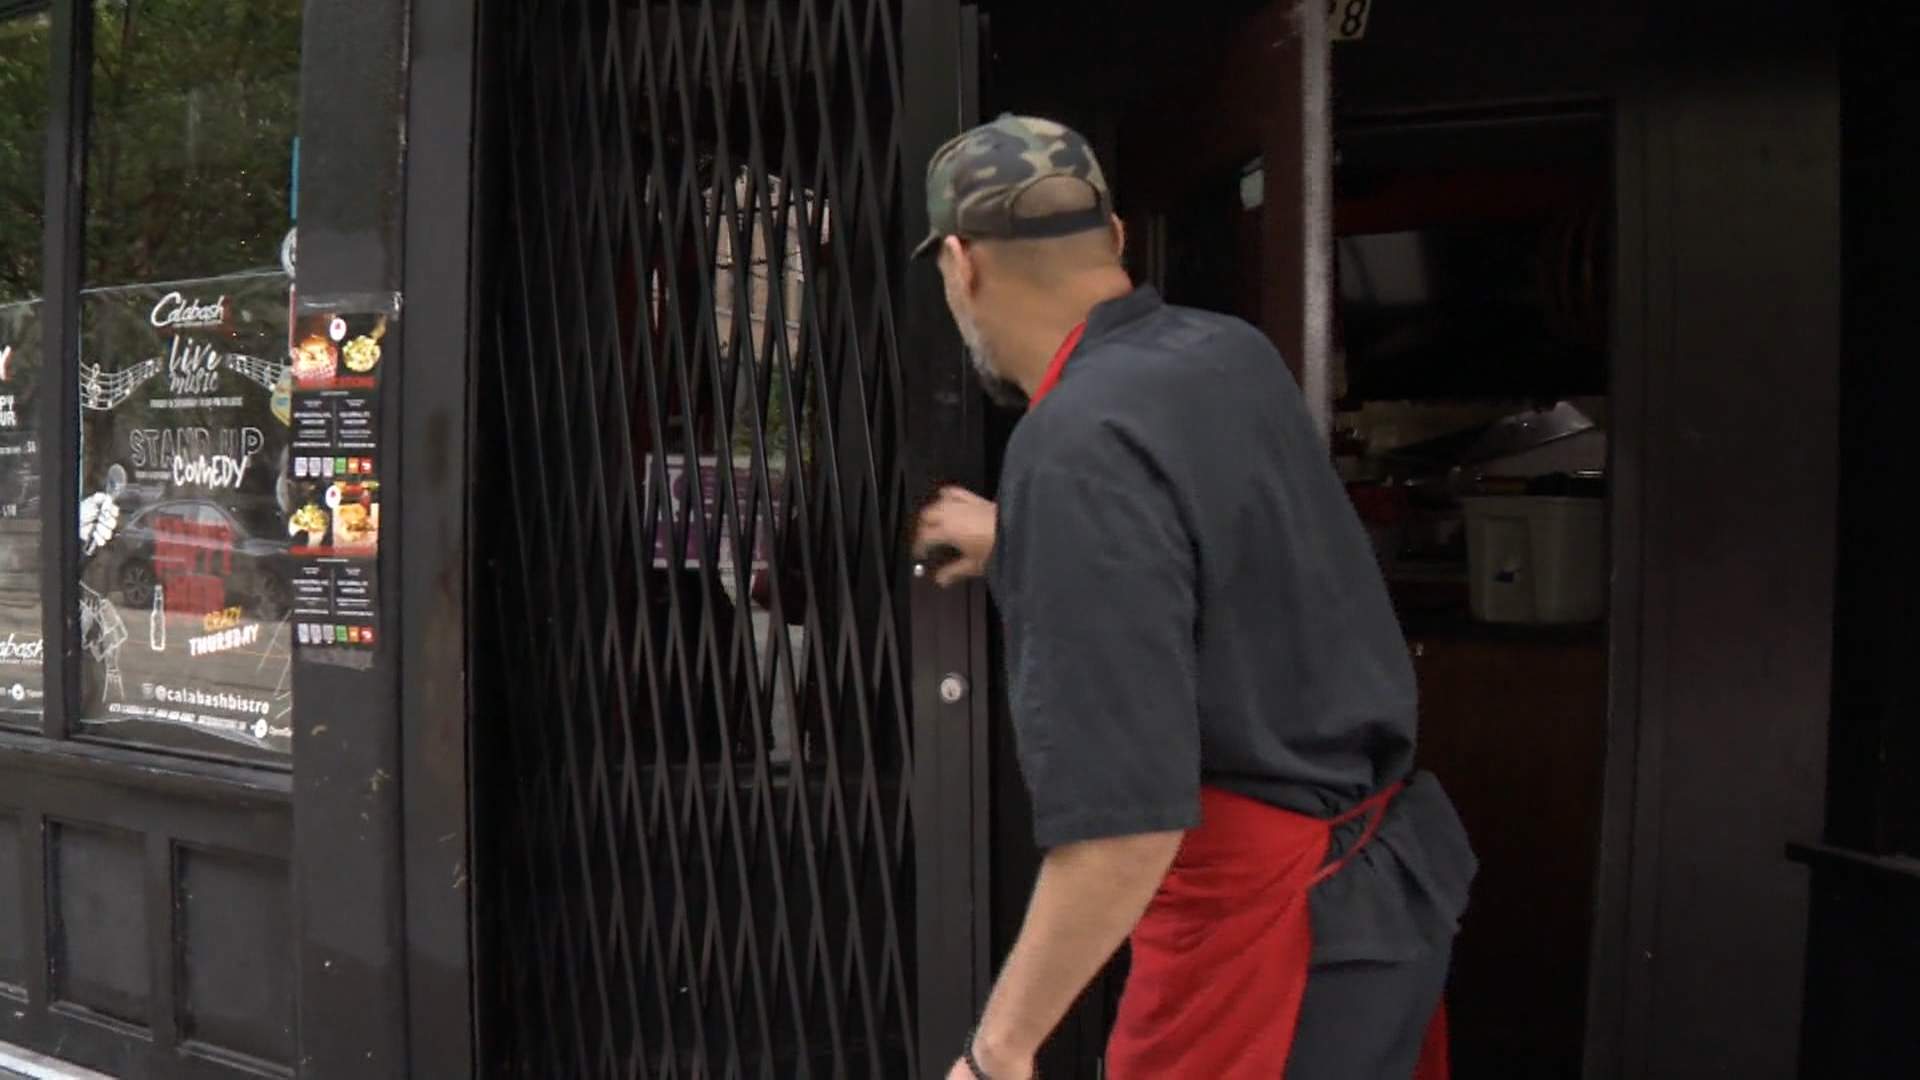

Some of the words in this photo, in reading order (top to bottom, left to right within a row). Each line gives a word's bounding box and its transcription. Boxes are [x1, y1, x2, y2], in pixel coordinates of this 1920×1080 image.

[151, 291, 225, 328] Calabash
[129, 427, 210, 468] STAND
[220, 426, 265, 468] UP
[188, 624, 260, 657] THURSDAY
[154, 684, 270, 716] @calabashbistro
